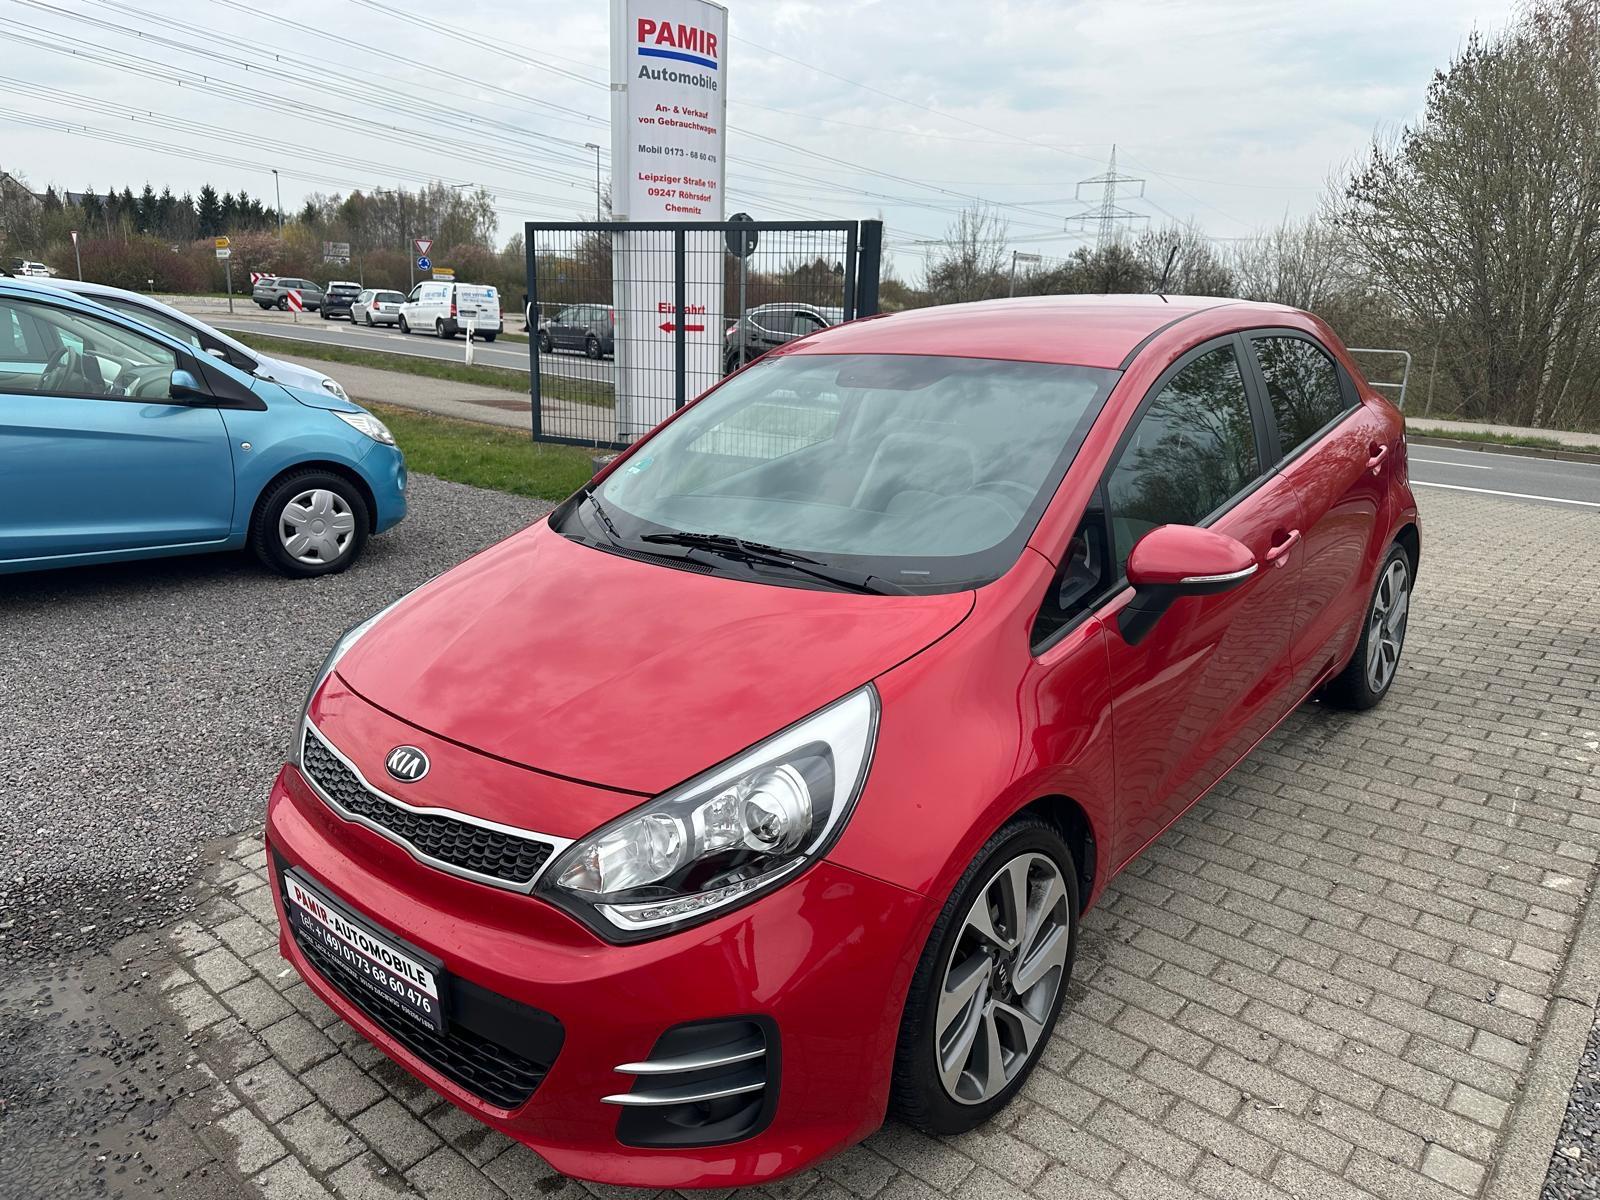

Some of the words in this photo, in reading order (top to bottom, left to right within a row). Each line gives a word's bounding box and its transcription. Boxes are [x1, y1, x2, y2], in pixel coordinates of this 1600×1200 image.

[638, 18, 717, 58] PAMIR
[638, 65, 717, 91] Automobile
[656, 104, 670, 112] An-
[673, 105, 679, 114] &
[682, 107, 708, 119] Verkauf
[657, 117, 717, 134] Gebrauchtwagen
[638, 144, 662, 155] Mobil
[664, 146, 684, 157] 0173
[638, 172, 681, 184] Leipziger
[683, 176, 706, 188] Straße
[647, 188, 676, 198] 09247
[679, 190, 711, 202] Röhrsdorf
[665, 203, 702, 215] Chemnitz
[387, 749, 421, 778] KIA
[323, 928, 342, 956] (49)
[343, 945, 370, 974] 0173
[372, 966, 387, 985] 68
[389, 977, 404, 996] 60
[407, 988, 431, 1013] 476
